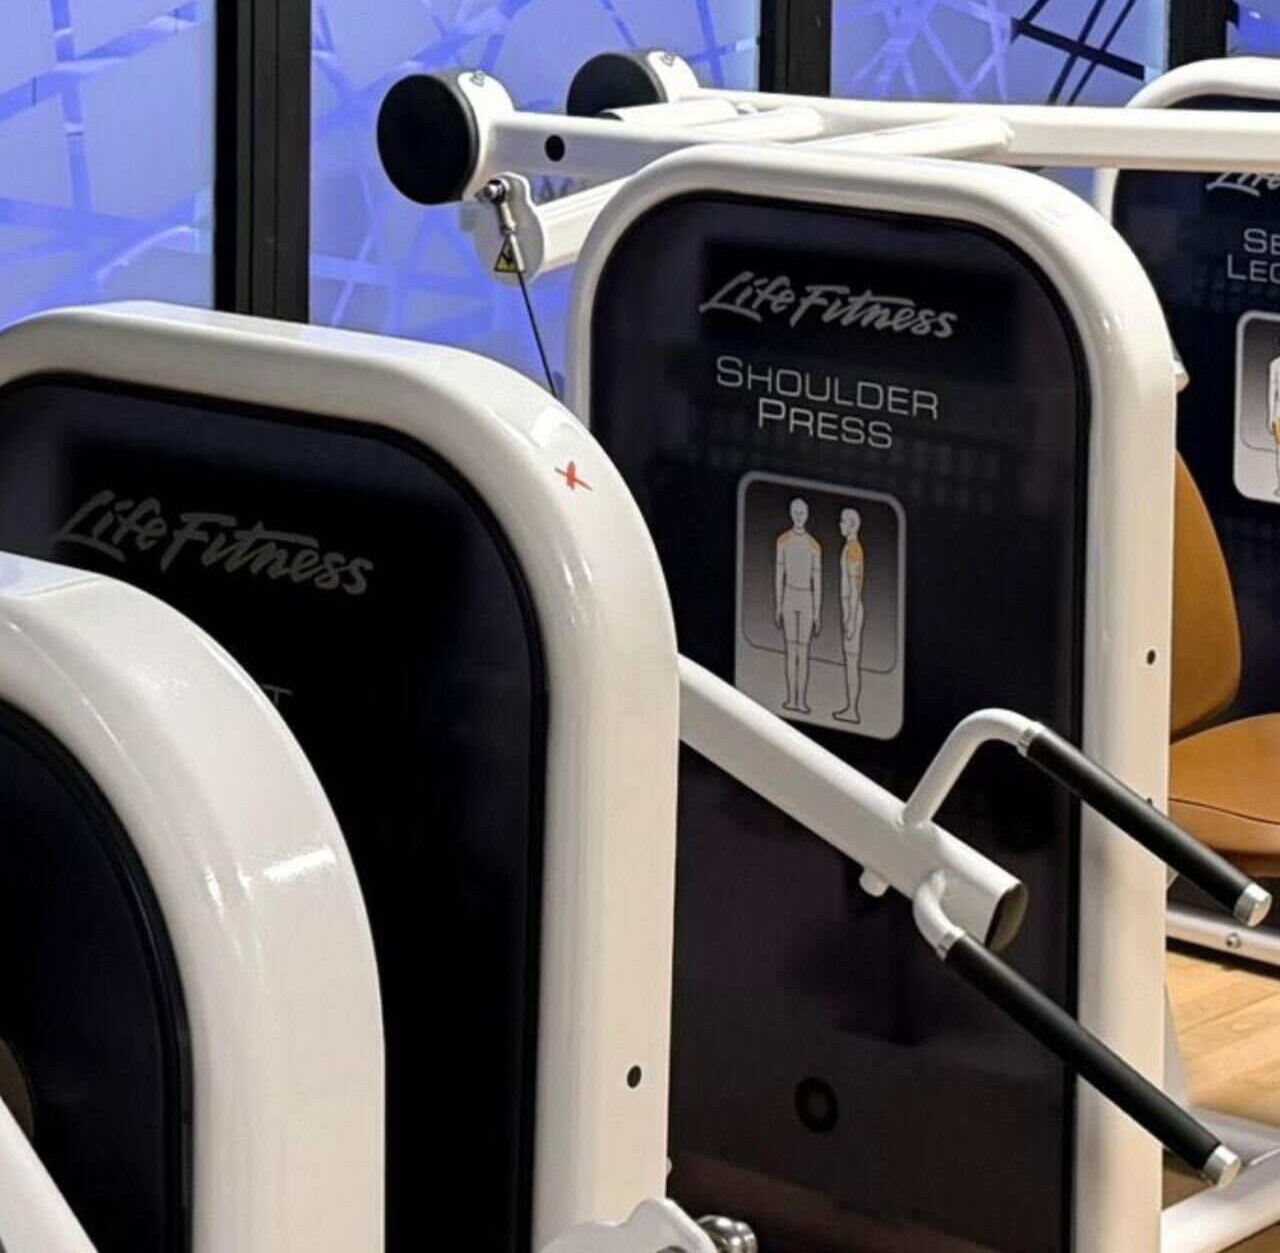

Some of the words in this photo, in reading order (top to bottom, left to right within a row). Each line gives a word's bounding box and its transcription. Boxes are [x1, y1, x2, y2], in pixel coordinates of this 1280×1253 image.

[699, 271, 795, 323] Life
[790, 285, 958, 338] Fitness
[716, 355, 939, 420] SHOULDER
[758, 397, 893, 449] PRESS
[53, 490, 166, 562] Life
[160, 513, 374, 595] Fitness
